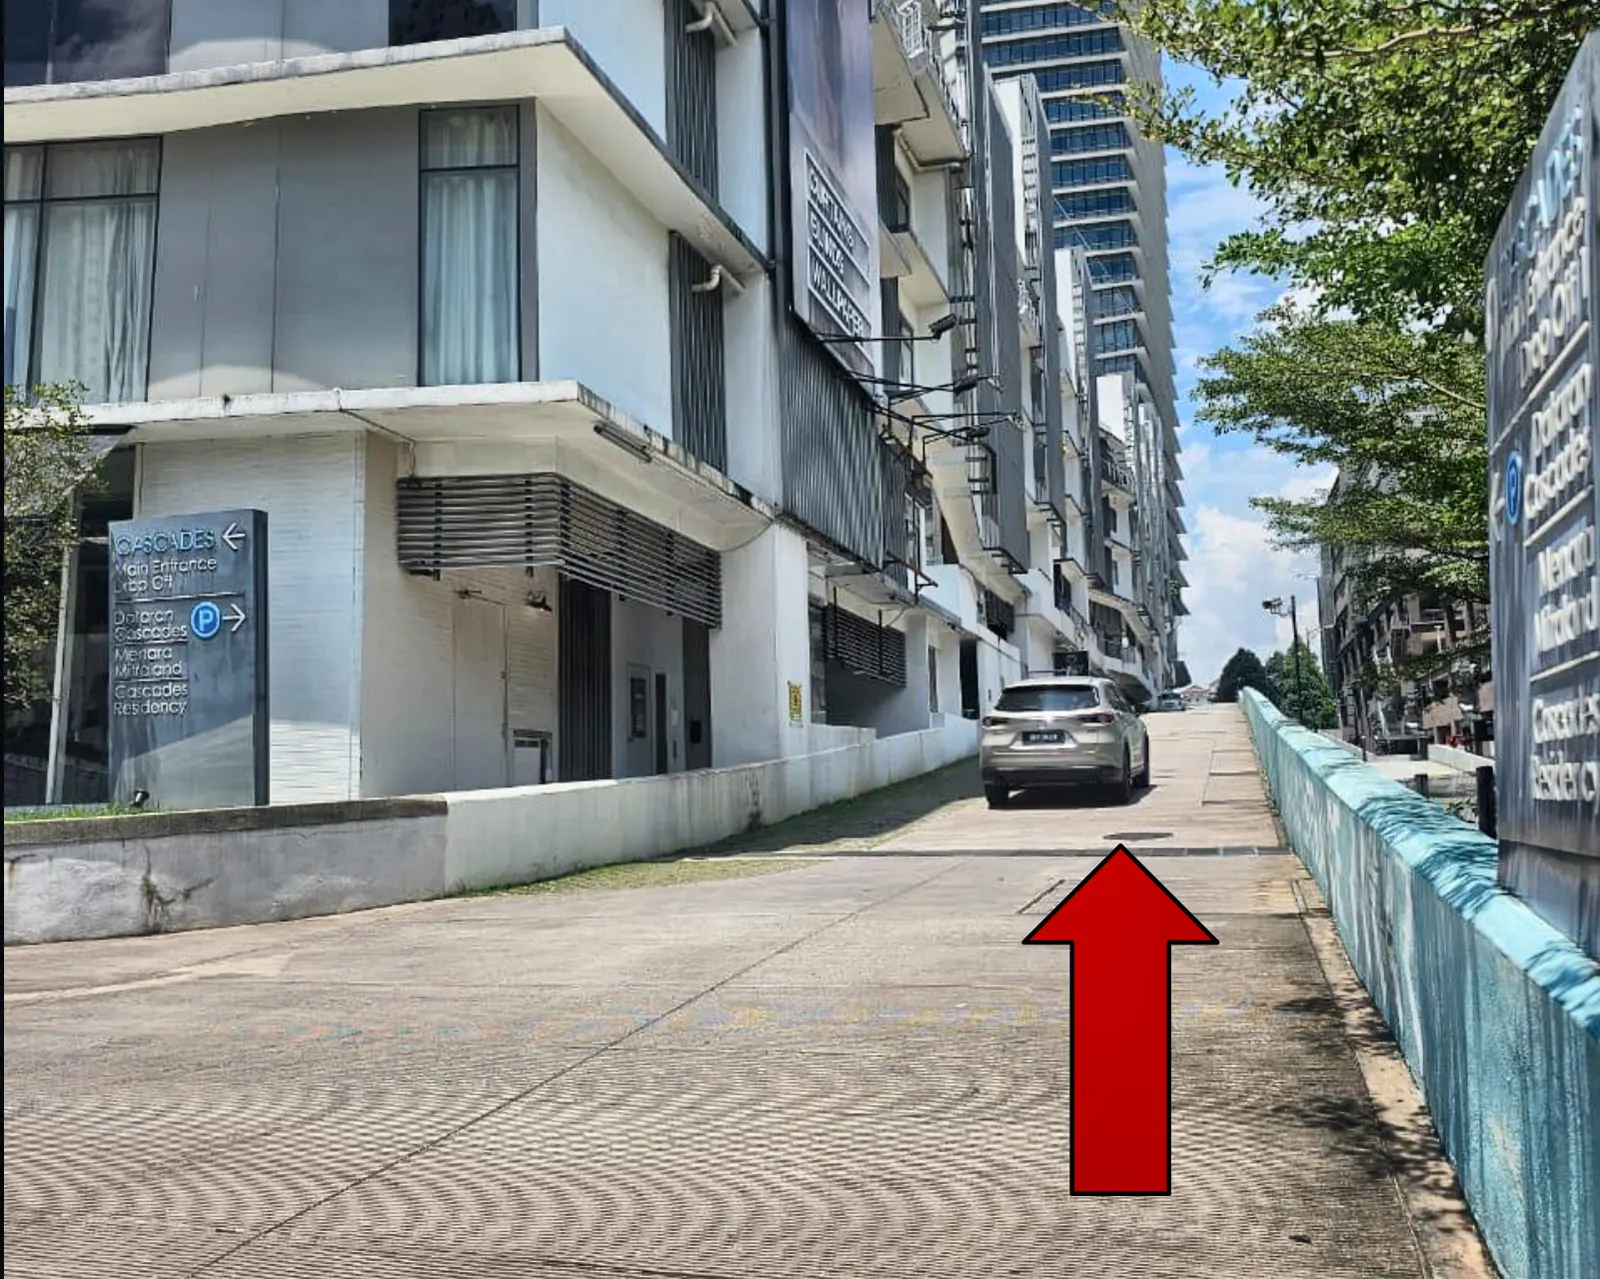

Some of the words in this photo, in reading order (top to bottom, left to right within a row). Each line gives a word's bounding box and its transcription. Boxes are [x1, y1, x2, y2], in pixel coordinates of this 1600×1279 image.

[114, 530, 217, 556] CASCADES
[114, 561, 149, 578] Main
[152, 557, 217, 574] Entrance
[113, 608, 174, 626] Dataran
[114, 624, 188, 643] Cascades
[114, 647, 172, 662] Menara
[114, 660, 182, 677] Mitraland
[114, 680, 189, 699] Cascades
[113, 699, 188, 716] Residency
